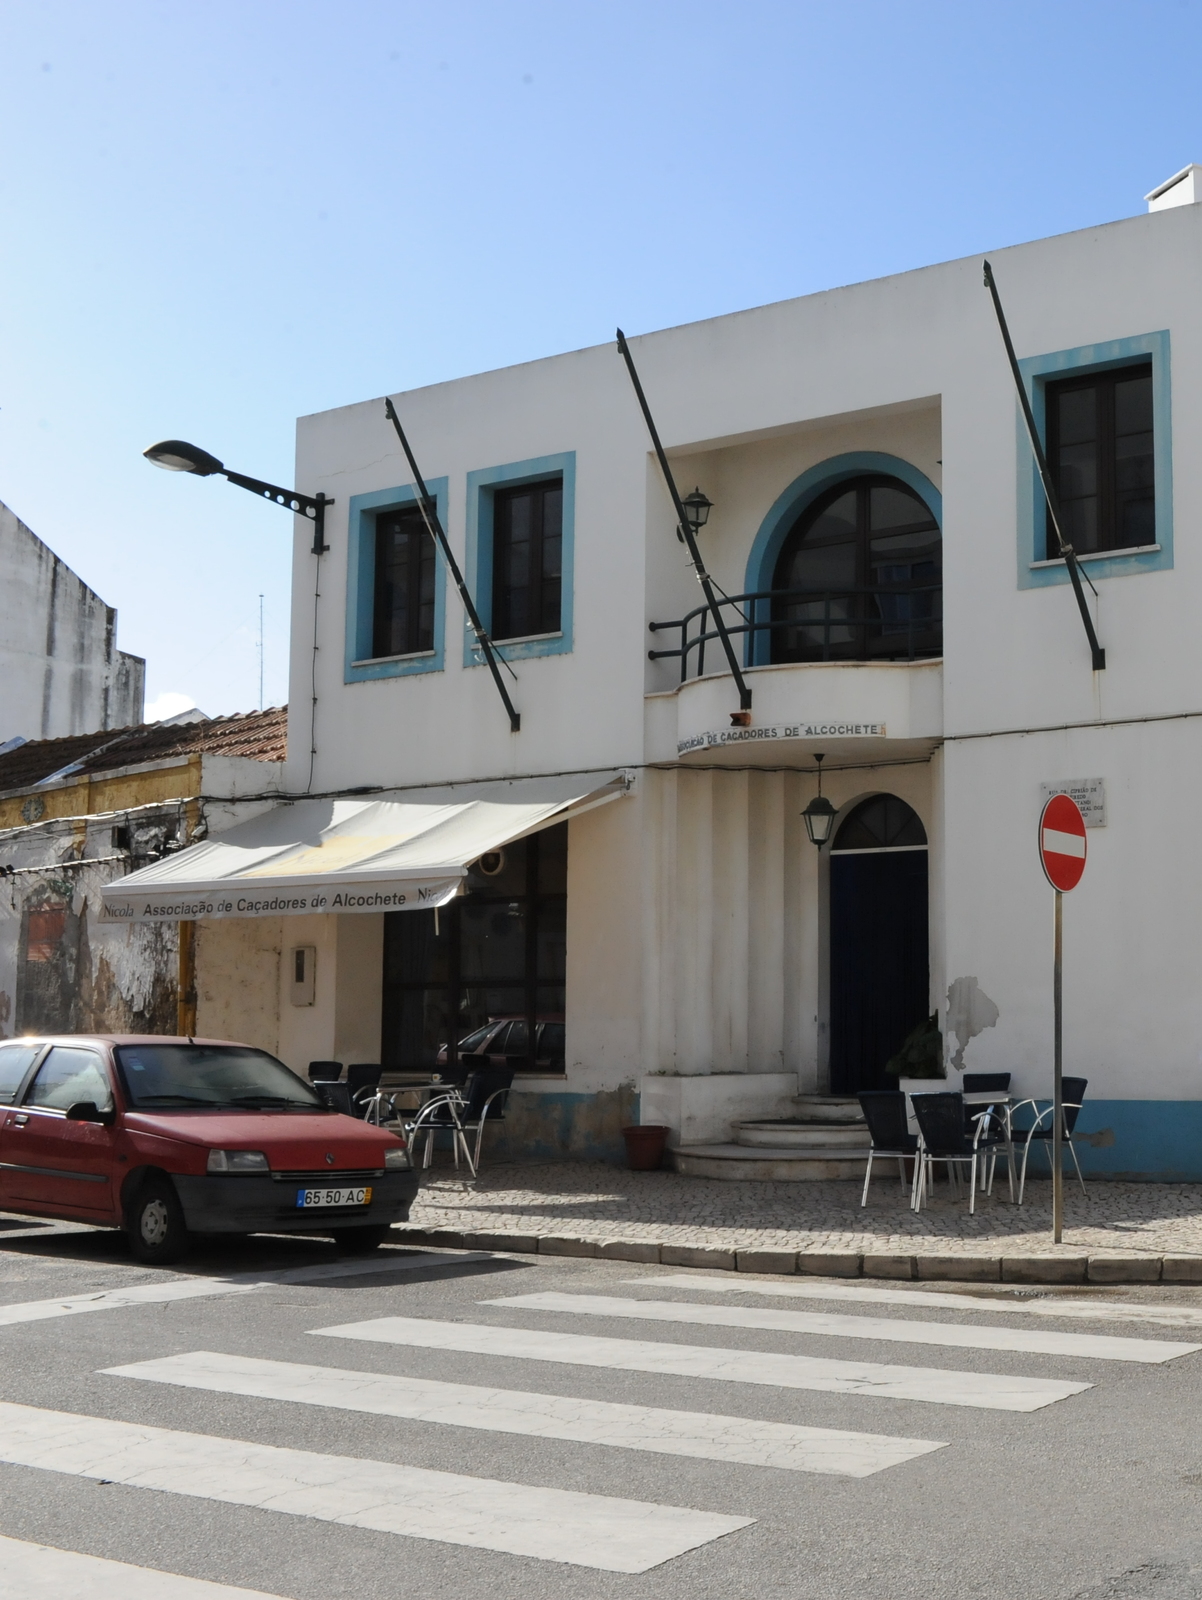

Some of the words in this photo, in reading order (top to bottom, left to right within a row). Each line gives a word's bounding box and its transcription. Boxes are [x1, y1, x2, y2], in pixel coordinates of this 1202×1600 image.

[707, 734, 718, 744] DE
[784, 727, 800, 737] DE
[805, 725, 878, 736] ALCOCHETE
[103, 903, 134, 918] Nicola
[143, 900, 214, 918] Associação
[217, 899, 233, 912] de
[236, 897, 307, 915] Caçadores
[311, 894, 327, 908] de
[332, 892, 406, 908] Alcochete
